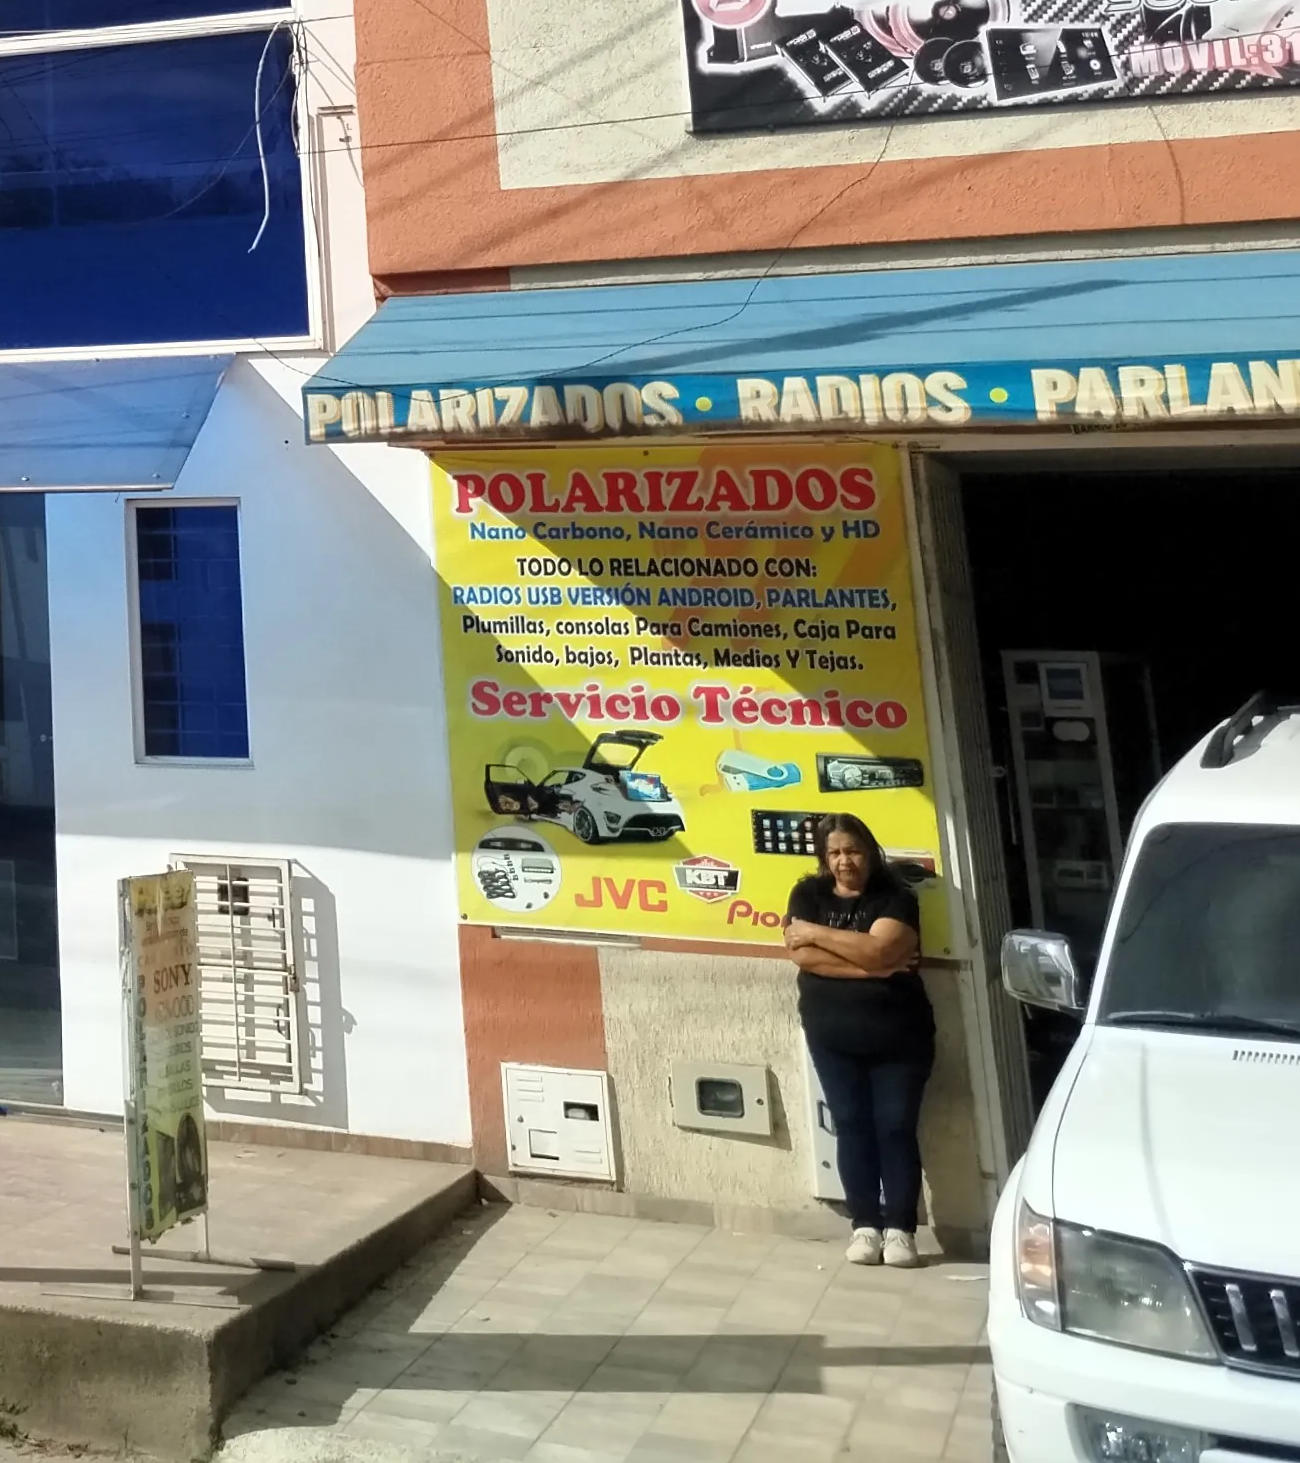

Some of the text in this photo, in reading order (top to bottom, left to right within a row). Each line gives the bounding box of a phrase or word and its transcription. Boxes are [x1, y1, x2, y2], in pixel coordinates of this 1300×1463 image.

[305, 359, 1300, 441] POLARIZADOS RADIOS PARLAN
[454, 467, 877, 515] POLARIZADOS
[469, 519, 881, 542] Nano Carbono, Nano Cerámico y HD
[516, 557, 818, 578] TODO LO RELACIONADO CON:
[452, 582, 897, 612] RADIOS USB VERSIÓN ANDROID, PARLANTES,
[462, 614, 897, 642] Plumillas, consolas Para Camiones, Caja Para
[495, 644, 864, 673] Sonido, bajos, Plantas, Medios Y Tejas.
[470, 680, 909, 730] Servicio Técnico
[574, 868, 729, 913] JVC KBT
[153, 963, 193, 994] SONY
